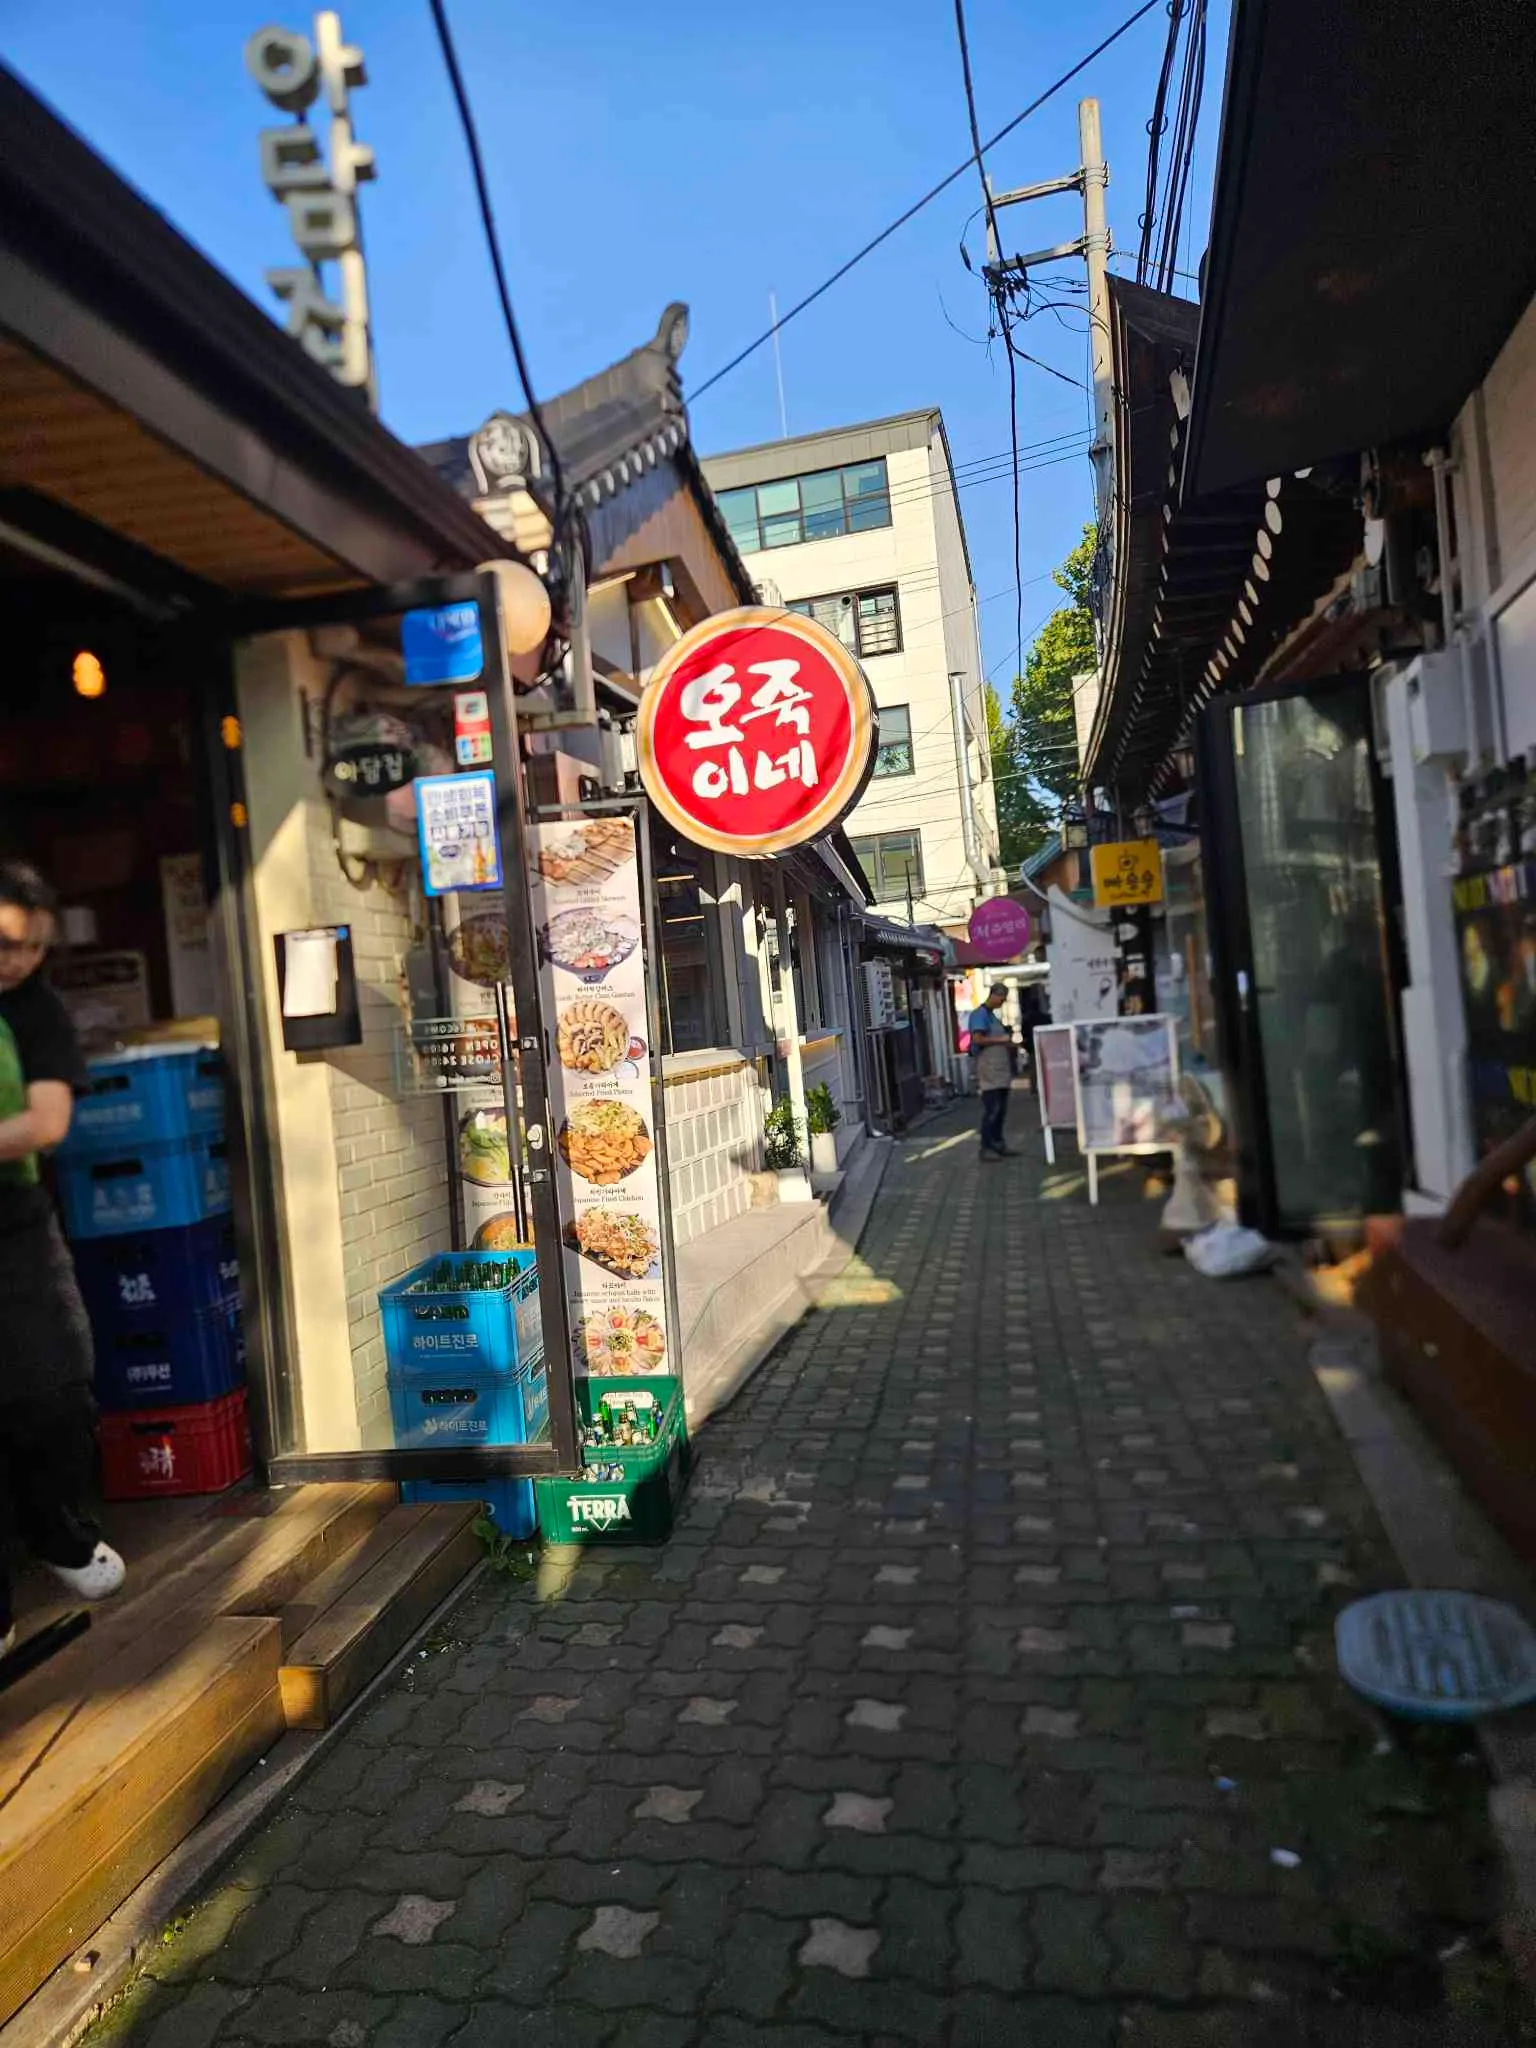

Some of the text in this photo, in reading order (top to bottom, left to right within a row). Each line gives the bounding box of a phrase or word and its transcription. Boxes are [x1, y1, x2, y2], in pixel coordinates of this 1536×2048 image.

[680, 658, 814, 750] 오죽
[692, 739, 819, 799] 이네
[412, 1333, 479, 1351] 하이트진로
[438, 1419, 489, 1433] 하이트진로
[566, 1494, 633, 1522] TERRA
